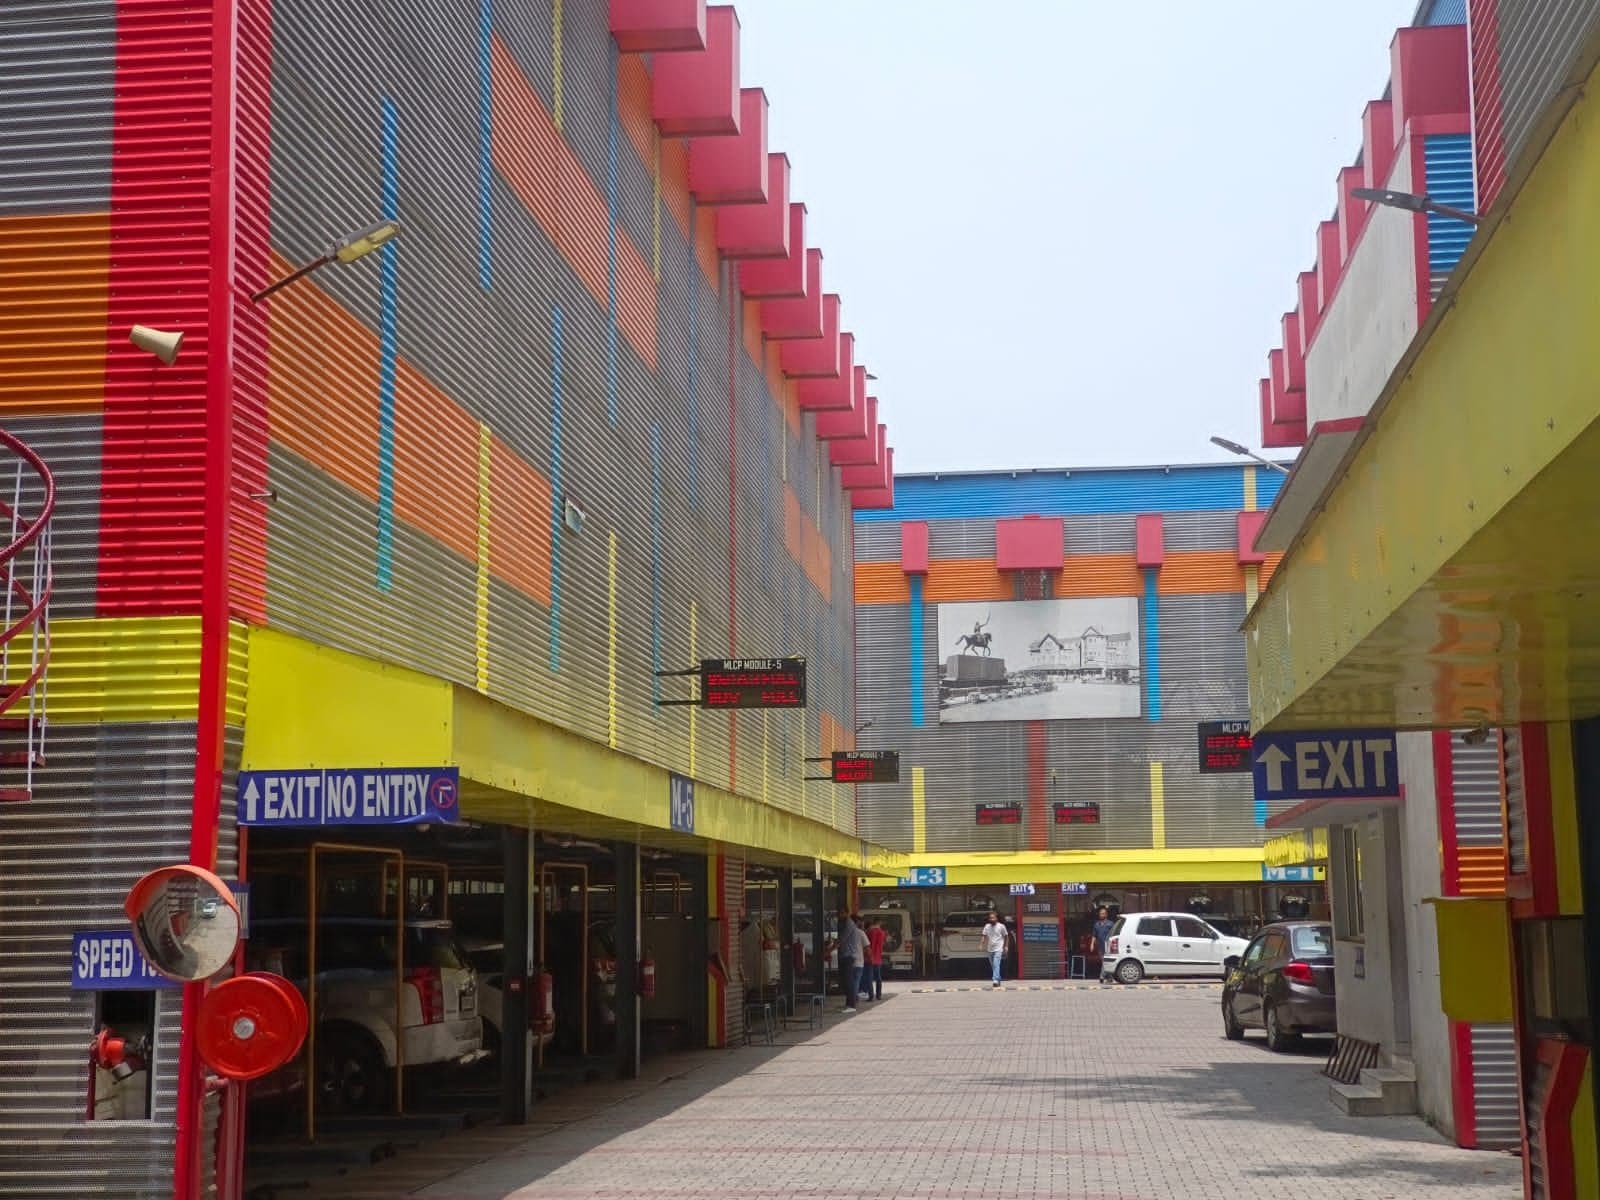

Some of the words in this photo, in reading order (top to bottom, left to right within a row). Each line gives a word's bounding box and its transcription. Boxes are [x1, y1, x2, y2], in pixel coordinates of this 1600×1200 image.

[723, 660, 742, 671] MLCP
[1222, 722, 1245, 734] MLCP
[1295, 739, 1393, 790] EXIT
[264, 776, 321, 819] EXIT
[327, 775, 356, 818] NO
[363, 774, 431, 817] ENTRY
[671, 778, 693, 829] M-5
[1266, 867, 1309, 881] M-1
[1009, 883, 1028, 893] EXIT
[1062, 882, 1080, 892] EXIT
[78, 938, 134, 978] SPEED
